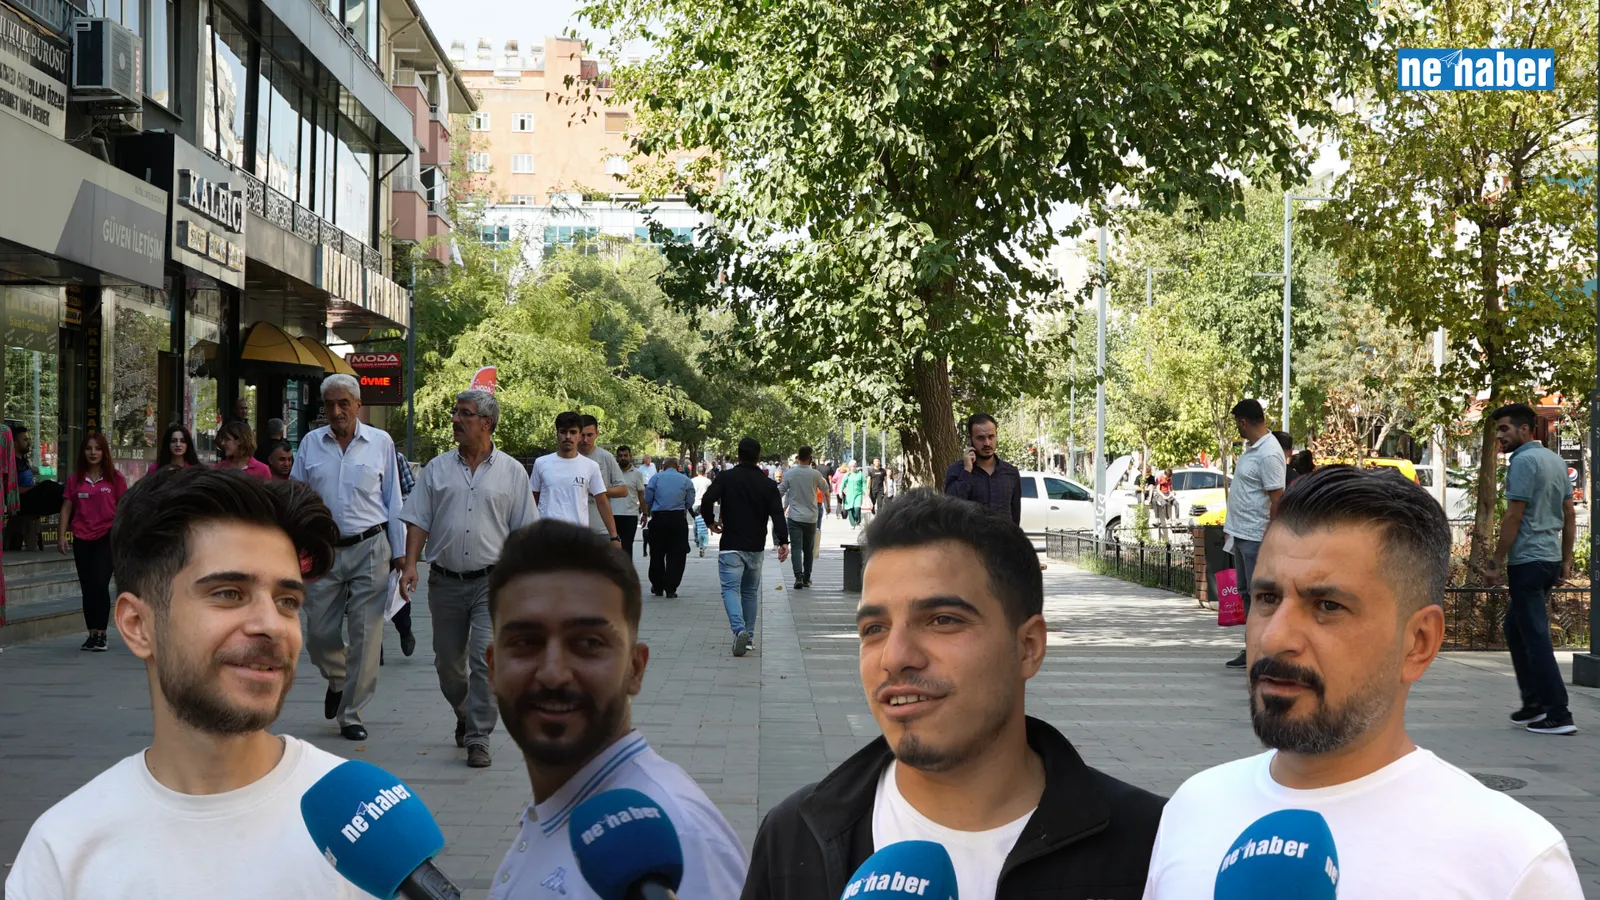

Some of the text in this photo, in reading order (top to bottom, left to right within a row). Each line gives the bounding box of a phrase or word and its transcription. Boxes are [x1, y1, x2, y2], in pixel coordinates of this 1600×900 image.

[0, 16, 29, 53] UKUK
[31, 34, 66, 74] BÜROSU
[103, 215, 163, 264] GÜVEN İLETİŞİM
[351, 354, 398, 363] MODA
[360, 375, 390, 386] ÖVME
[41, 528, 57, 542] miri
[341, 783, 411, 844] ne haber
[581, 806, 661, 845] ne haber
[1220, 836, 1309, 873] ne haber
[842, 871, 930, 900] ne haber
